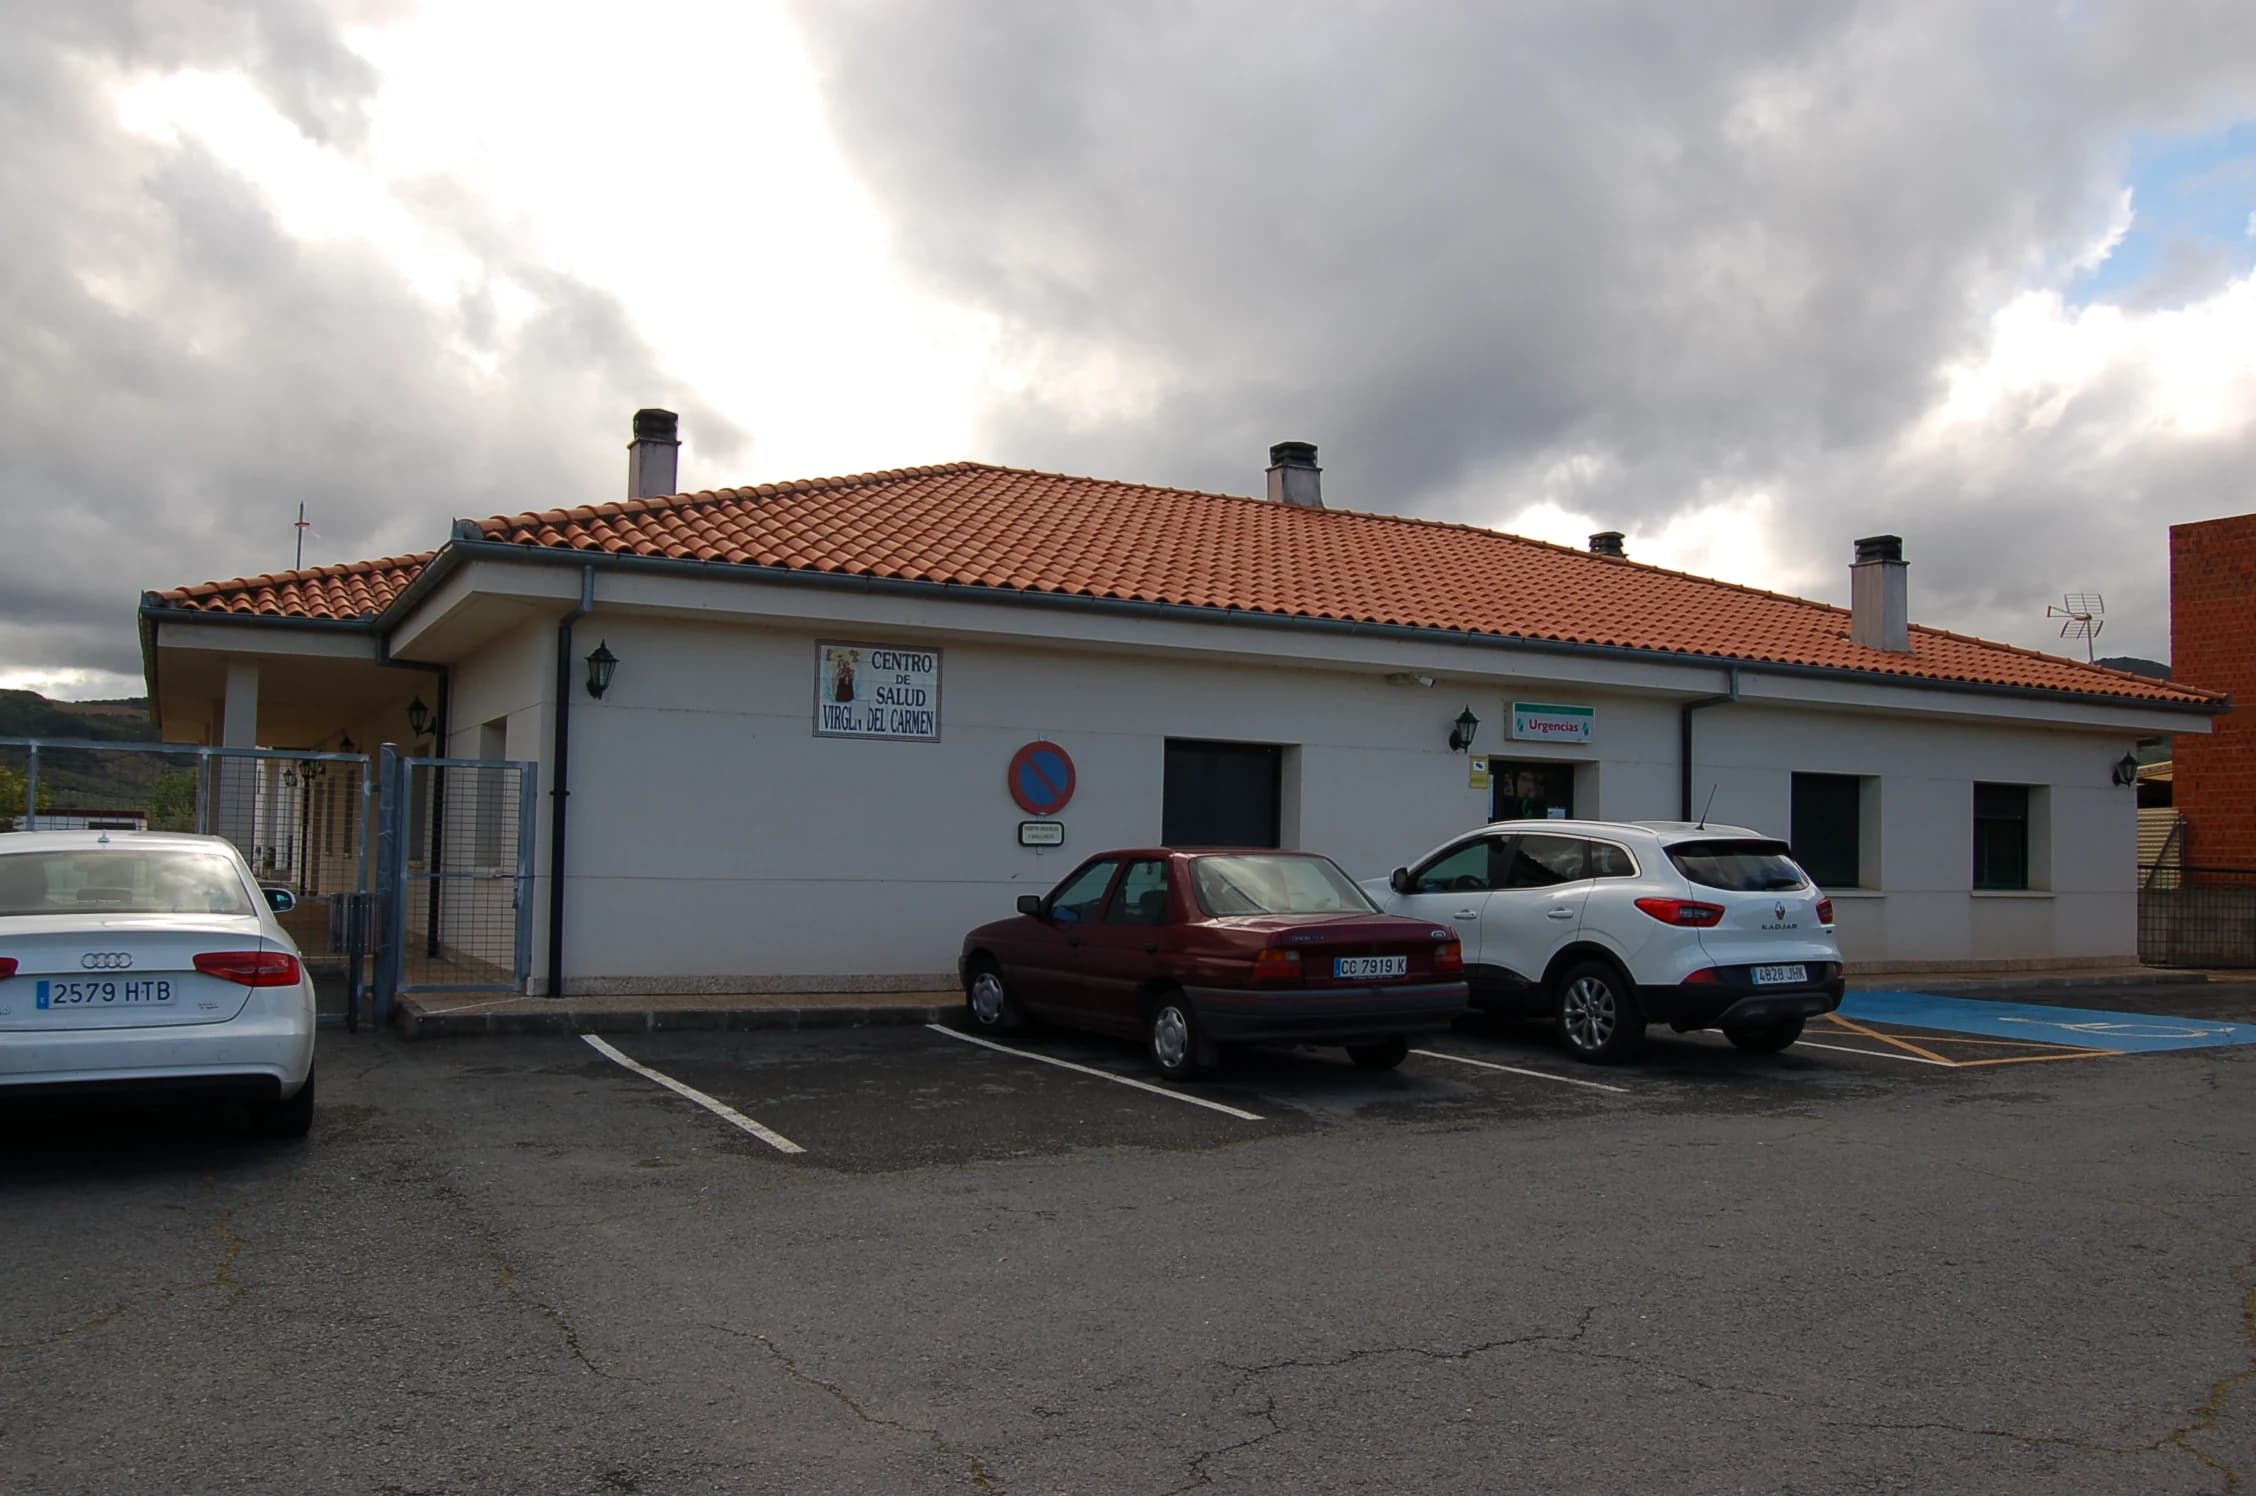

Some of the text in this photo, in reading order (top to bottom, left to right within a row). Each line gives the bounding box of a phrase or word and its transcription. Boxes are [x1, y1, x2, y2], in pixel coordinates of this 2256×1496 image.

[871, 651, 932, 673] CENTRO
[895, 674, 911, 685] DE
[876, 686, 926, 707] SALUD
[867, 707, 886, 732] DEL
[890, 708, 933, 735] CARMEN
[1529, 719, 1579, 733] Urgencias
[1361, 959, 1393, 974] 7919
[1397, 957, 1405, 973] K
[1759, 967, 1784, 982] 4828
[53, 981, 170, 1004] 2579 HTB
